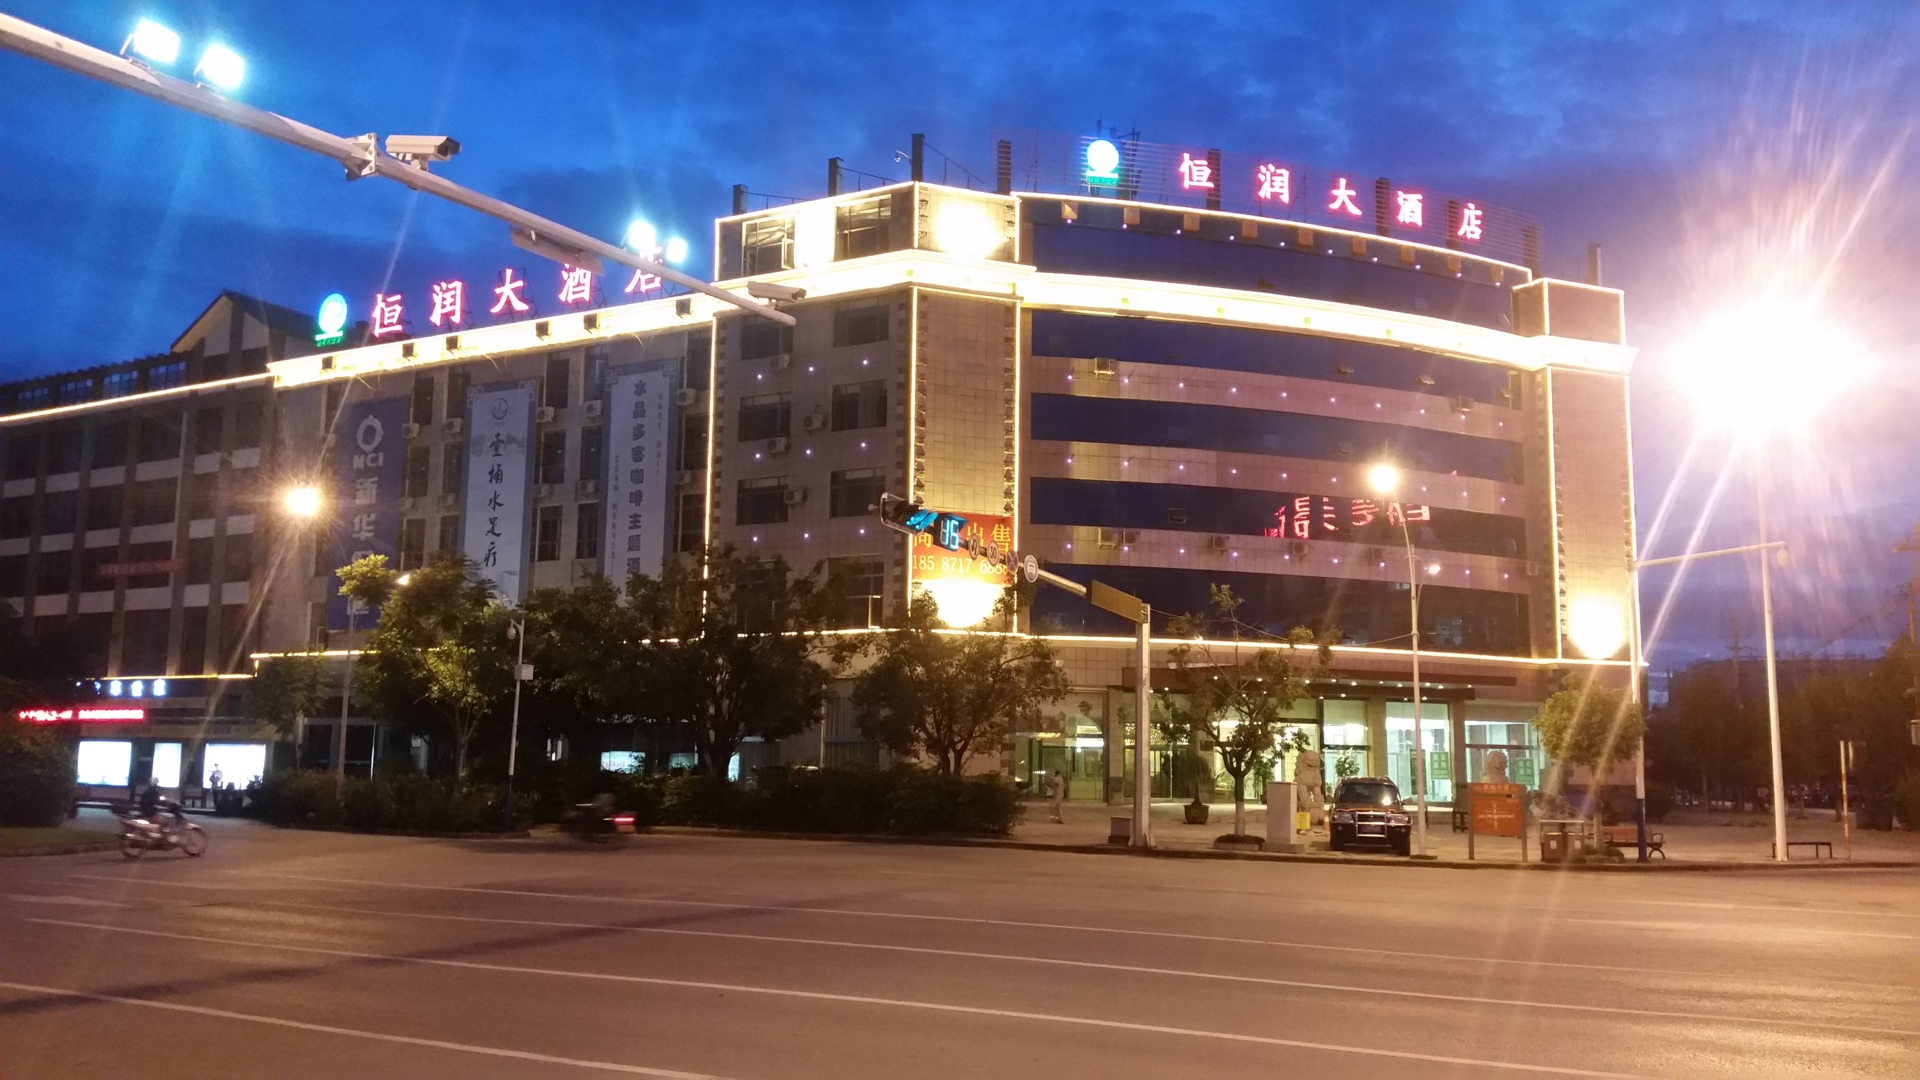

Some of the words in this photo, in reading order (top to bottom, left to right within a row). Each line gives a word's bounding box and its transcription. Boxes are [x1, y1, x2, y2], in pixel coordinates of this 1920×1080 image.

[1178, 152, 1485, 241] 恒润大酒店
[352, 452, 384, 470] NCI
[625, 379, 648, 597] 水晶多客咖啡主题酒
[990, 546, 997, 559] 30
[912, 555, 935, 571] 185
[941, 556, 972, 573] 8717
